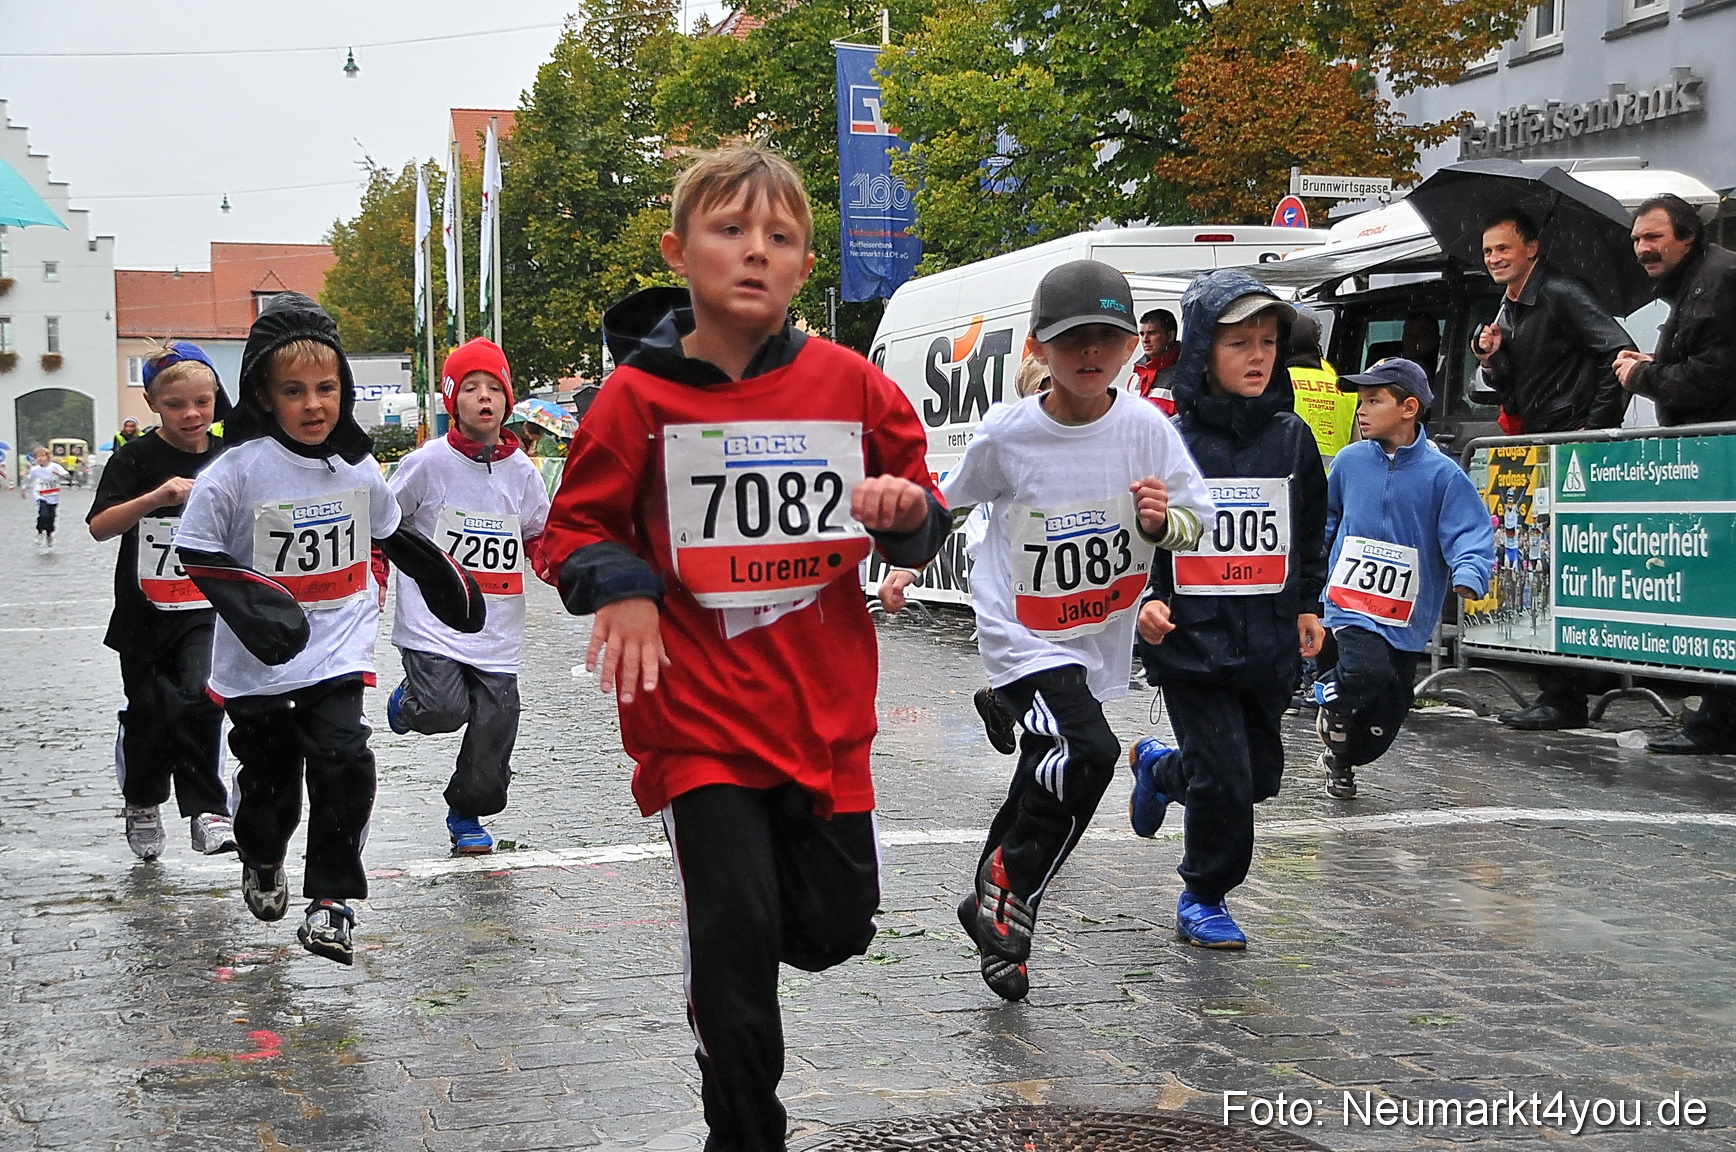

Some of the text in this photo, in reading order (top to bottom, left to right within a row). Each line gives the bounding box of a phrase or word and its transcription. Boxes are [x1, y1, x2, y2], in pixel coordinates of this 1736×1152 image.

[1459, 76, 1704, 161] Raiffeisenbank
[849, 173, 910, 211] 100
[1302, 178, 1388, 196] Brunnwirtsgasse
[849, 240, 893, 249] Raiffeisenbank
[849, 250, 881, 258] Neumarkt
[353, 384, 401, 402] OCK
[724, 434, 807, 456] BOCK
[948, 433, 966, 447] rent
[1590, 460, 1699, 486] Event-Leit-Systeme
[1209, 486, 1261, 500] BOCK
[293, 500, 344, 521] BOCK
[691, 471, 846, 540] 7082
[464, 517, 504, 530] BOCK
[1045, 510, 1106, 532] BOCK
[1191, 510, 1278, 553] 005
[269, 519, 356, 573] 7311
[680, 531, 687, 543] 4
[1562, 522, 1708, 558] Mehr Sicherheit
[446, 530, 519, 570] 7269
[1023, 528, 1132, 592] 7083
[1362, 544, 1403, 559] BOCK
[730, 555, 820, 584] Lorenz
[1221, 562, 1253, 581] Jan
[1342, 557, 1412, 598] 7301
[1561, 564, 1682, 603] für Ihr Event!
[1562, 625, 1587, 646] Miet
[1589, 627, 1599, 647] &
[1601, 629, 1639, 651] Service
[1641, 632, 1670, 654] Line:
[1672, 635, 1709, 658] 09181
